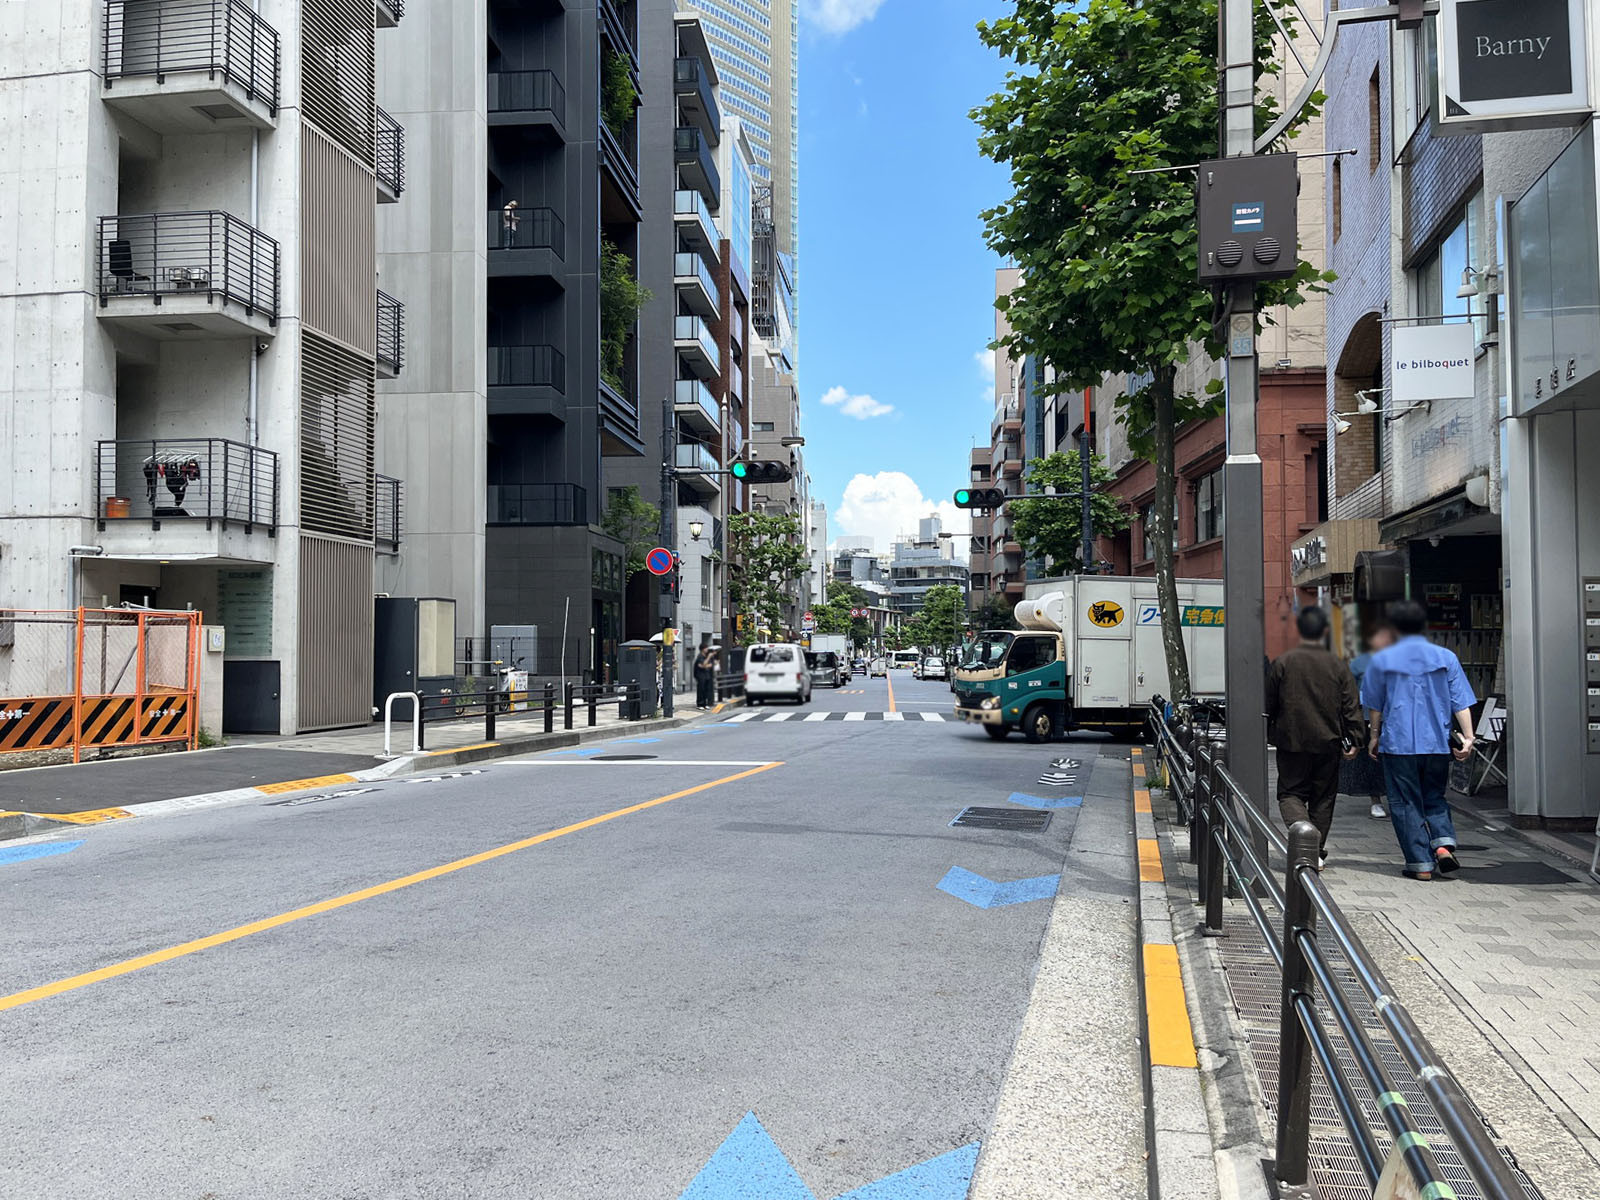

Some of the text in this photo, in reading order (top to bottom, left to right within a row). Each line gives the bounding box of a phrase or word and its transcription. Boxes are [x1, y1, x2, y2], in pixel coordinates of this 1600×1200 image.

[1475, 35, 1551, 59] Barny
[1396, 358, 1469, 370] le bilboquet
